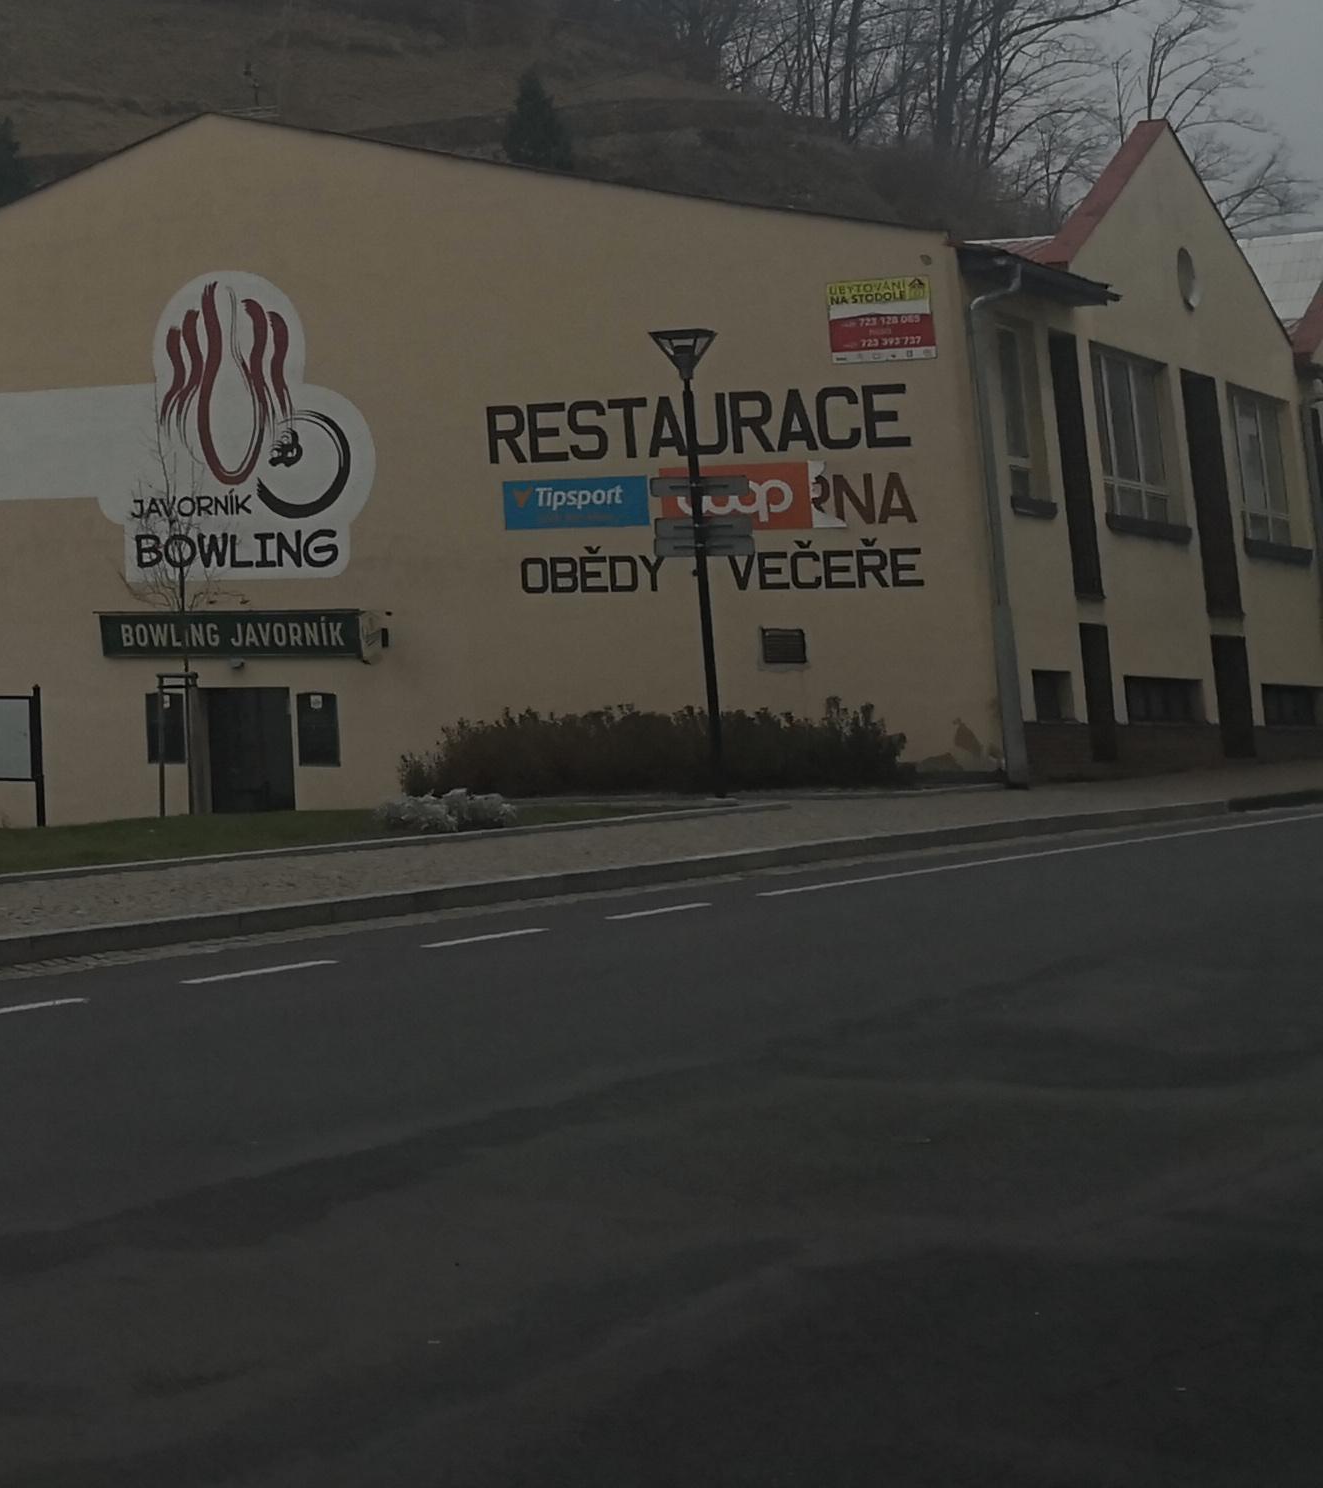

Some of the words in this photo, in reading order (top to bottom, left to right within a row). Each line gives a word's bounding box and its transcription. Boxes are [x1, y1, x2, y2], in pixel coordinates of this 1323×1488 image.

[830, 296, 849, 306] NA
[851, 290, 907, 304] STODOLE
[486, 383, 912, 464] RESTAURACE
[131, 488, 252, 518] JAVORNÍK
[535, 484, 624, 511] Tipsport
[135, 529, 339, 569] BOWLING
[521, 546, 665, 594] OBĚDY
[728, 537, 925, 591] VEČEŘE
[120, 622, 221, 648] BOWLING
[230, 616, 346, 647] JAVORNÍK
